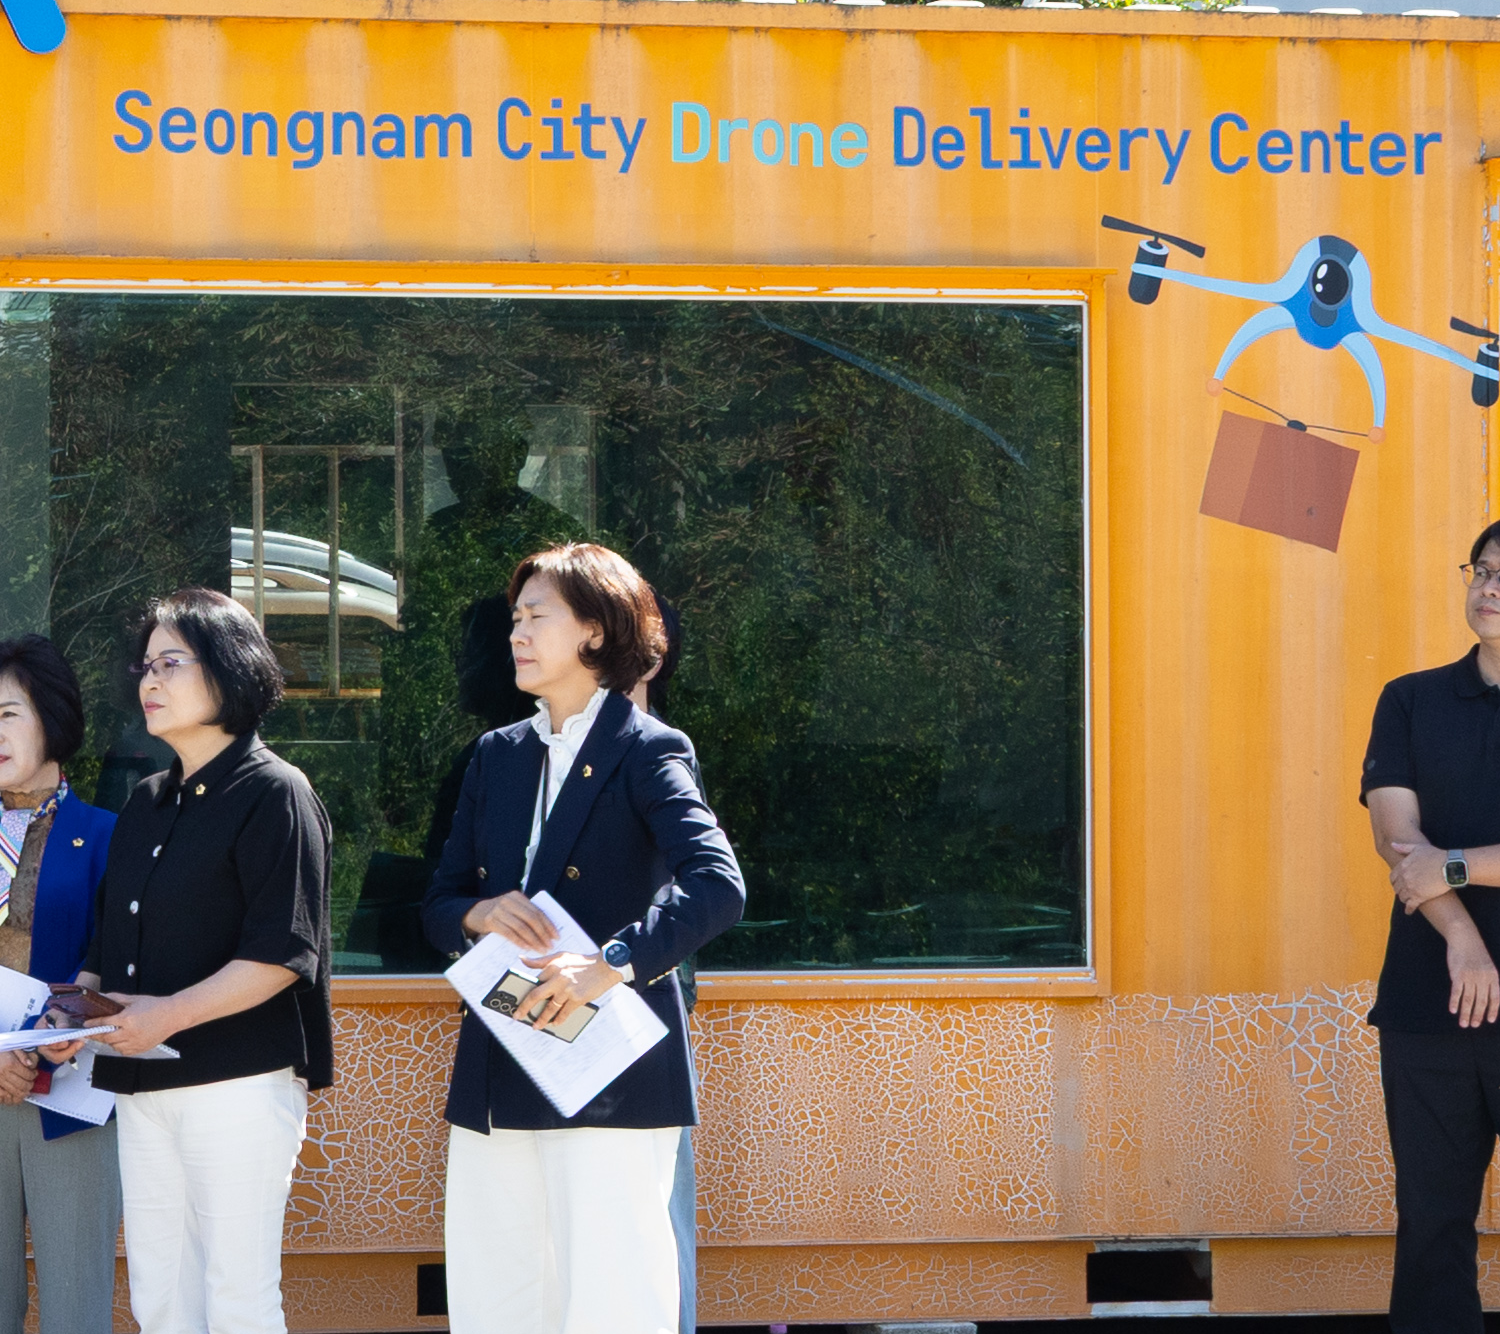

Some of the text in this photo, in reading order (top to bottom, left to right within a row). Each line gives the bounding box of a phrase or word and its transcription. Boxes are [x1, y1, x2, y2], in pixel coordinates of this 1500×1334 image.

[114, 90, 1442, 184] Seongnam City Drone Delivery Center
